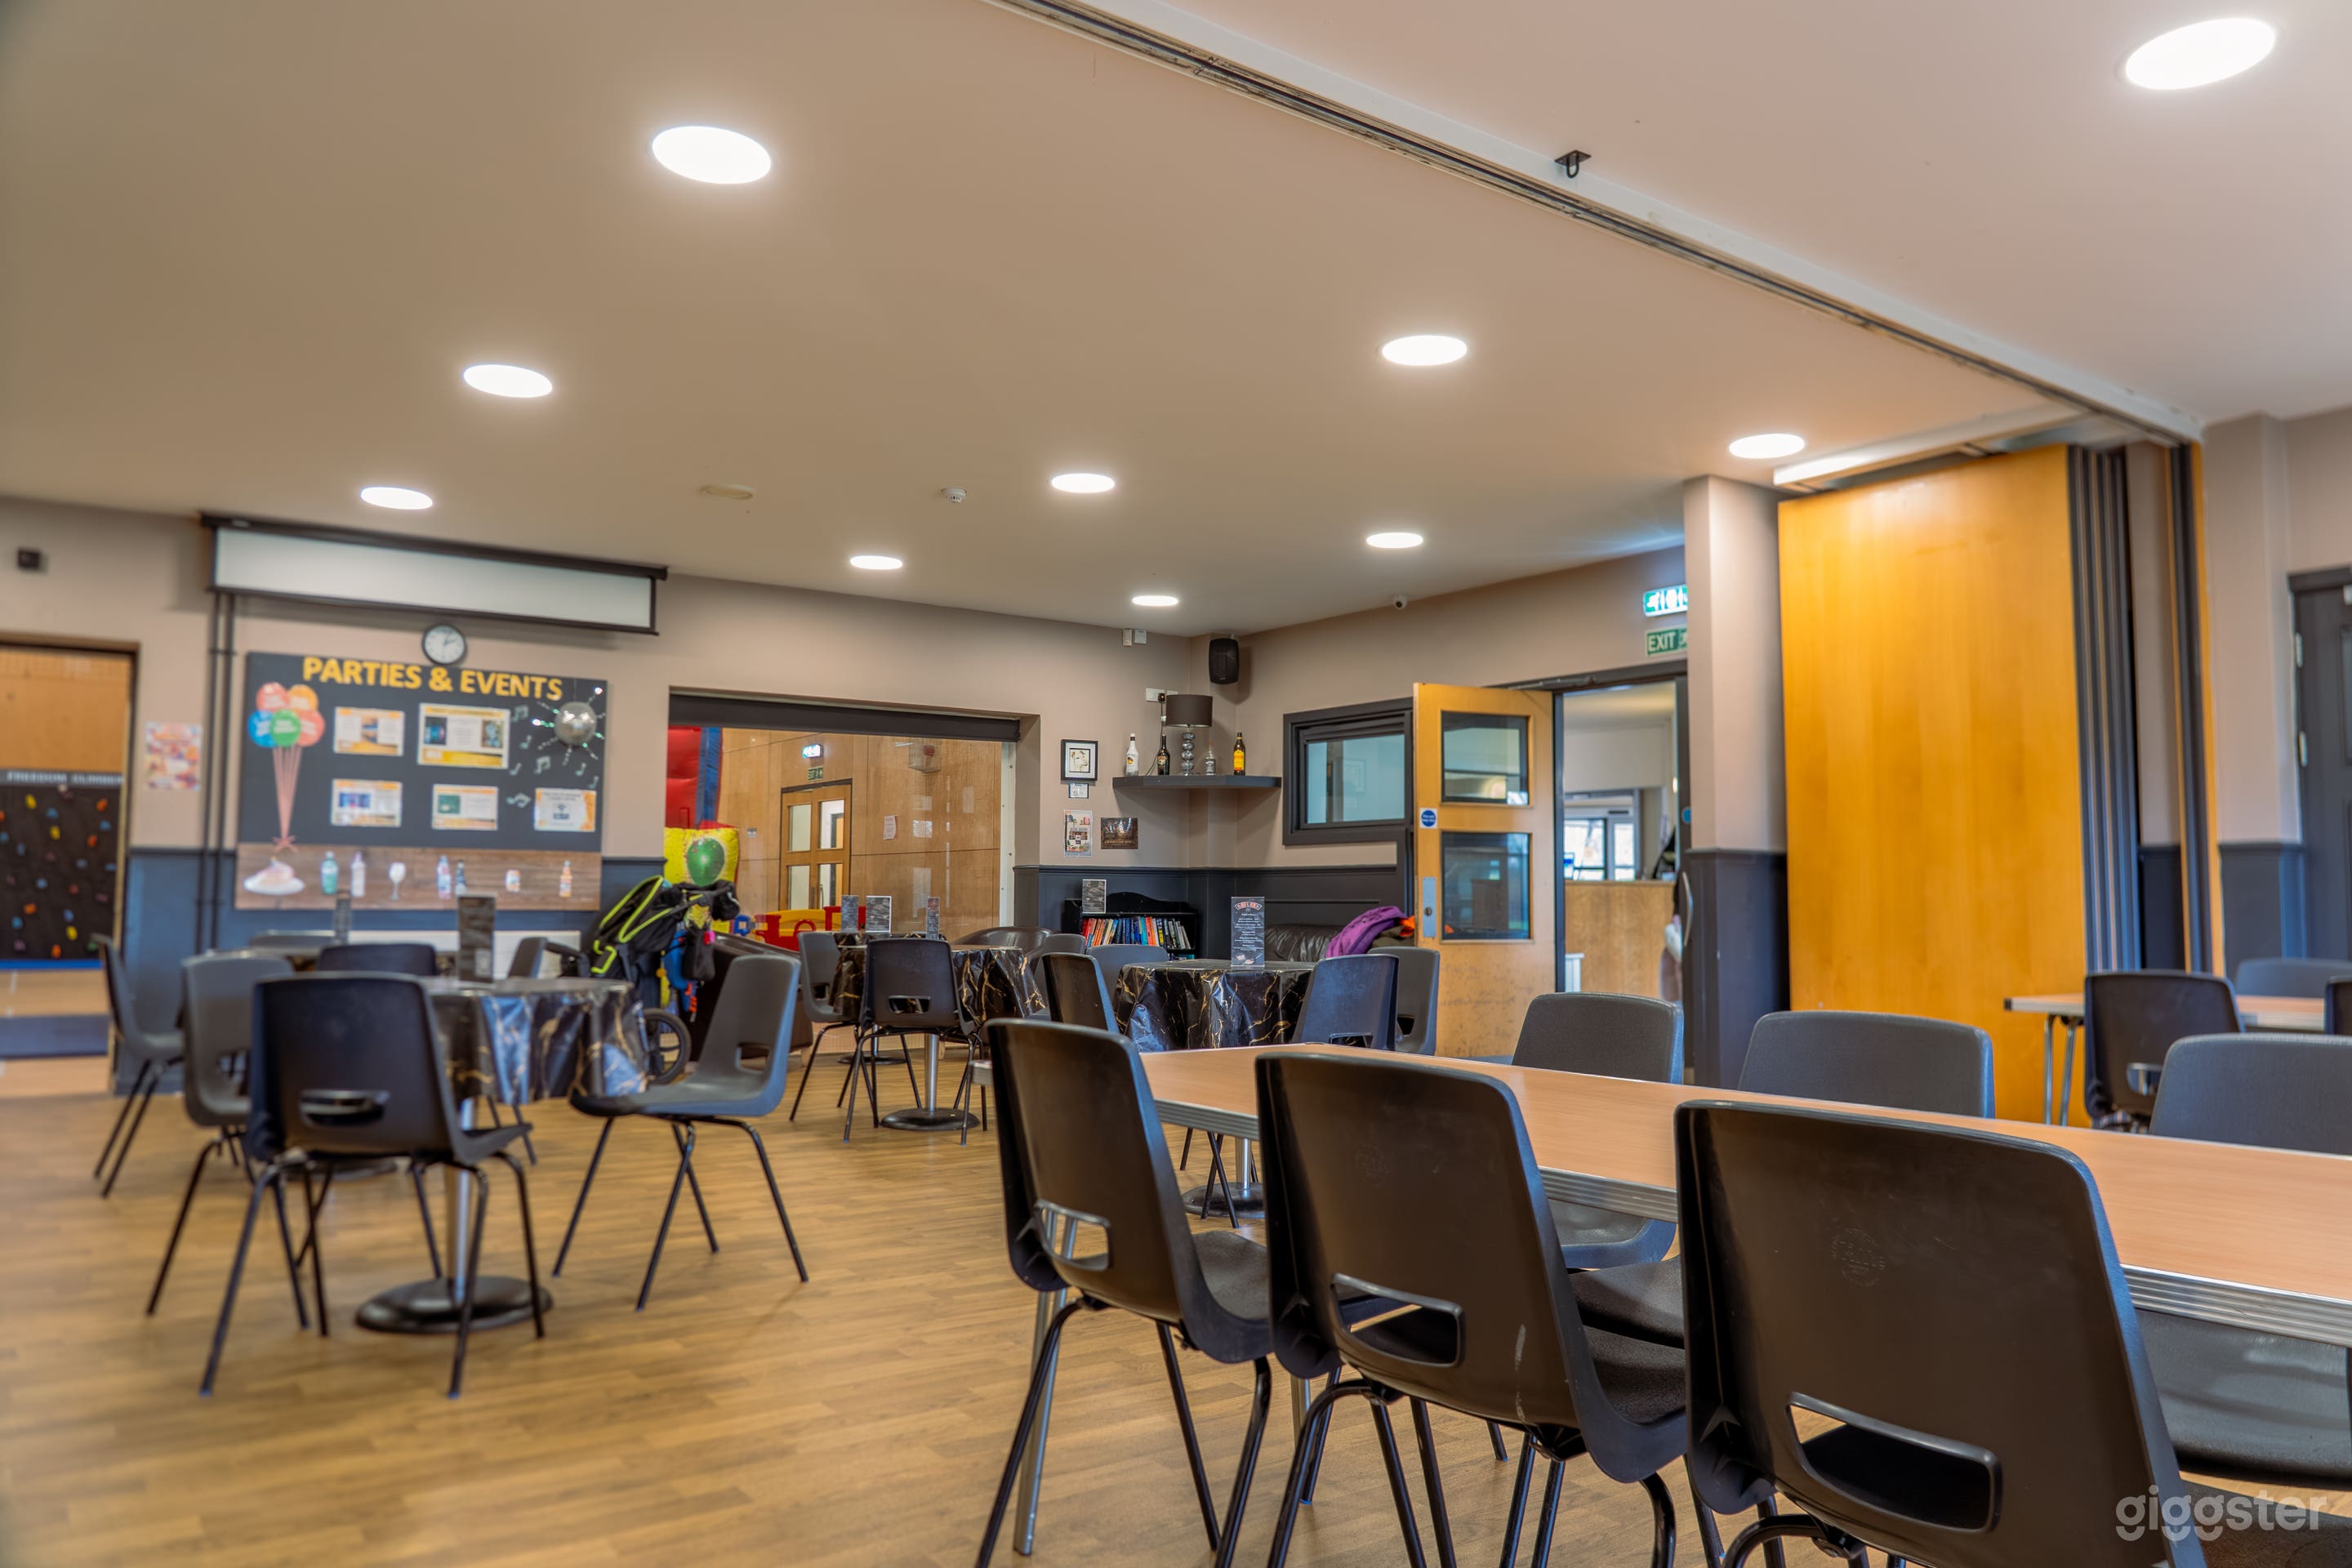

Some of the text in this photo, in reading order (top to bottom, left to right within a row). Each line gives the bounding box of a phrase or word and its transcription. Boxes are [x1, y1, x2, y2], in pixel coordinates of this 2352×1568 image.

[1648, 631, 1676, 652] EXIT
[303, 656, 563, 701] PARTIES & EVENTS
